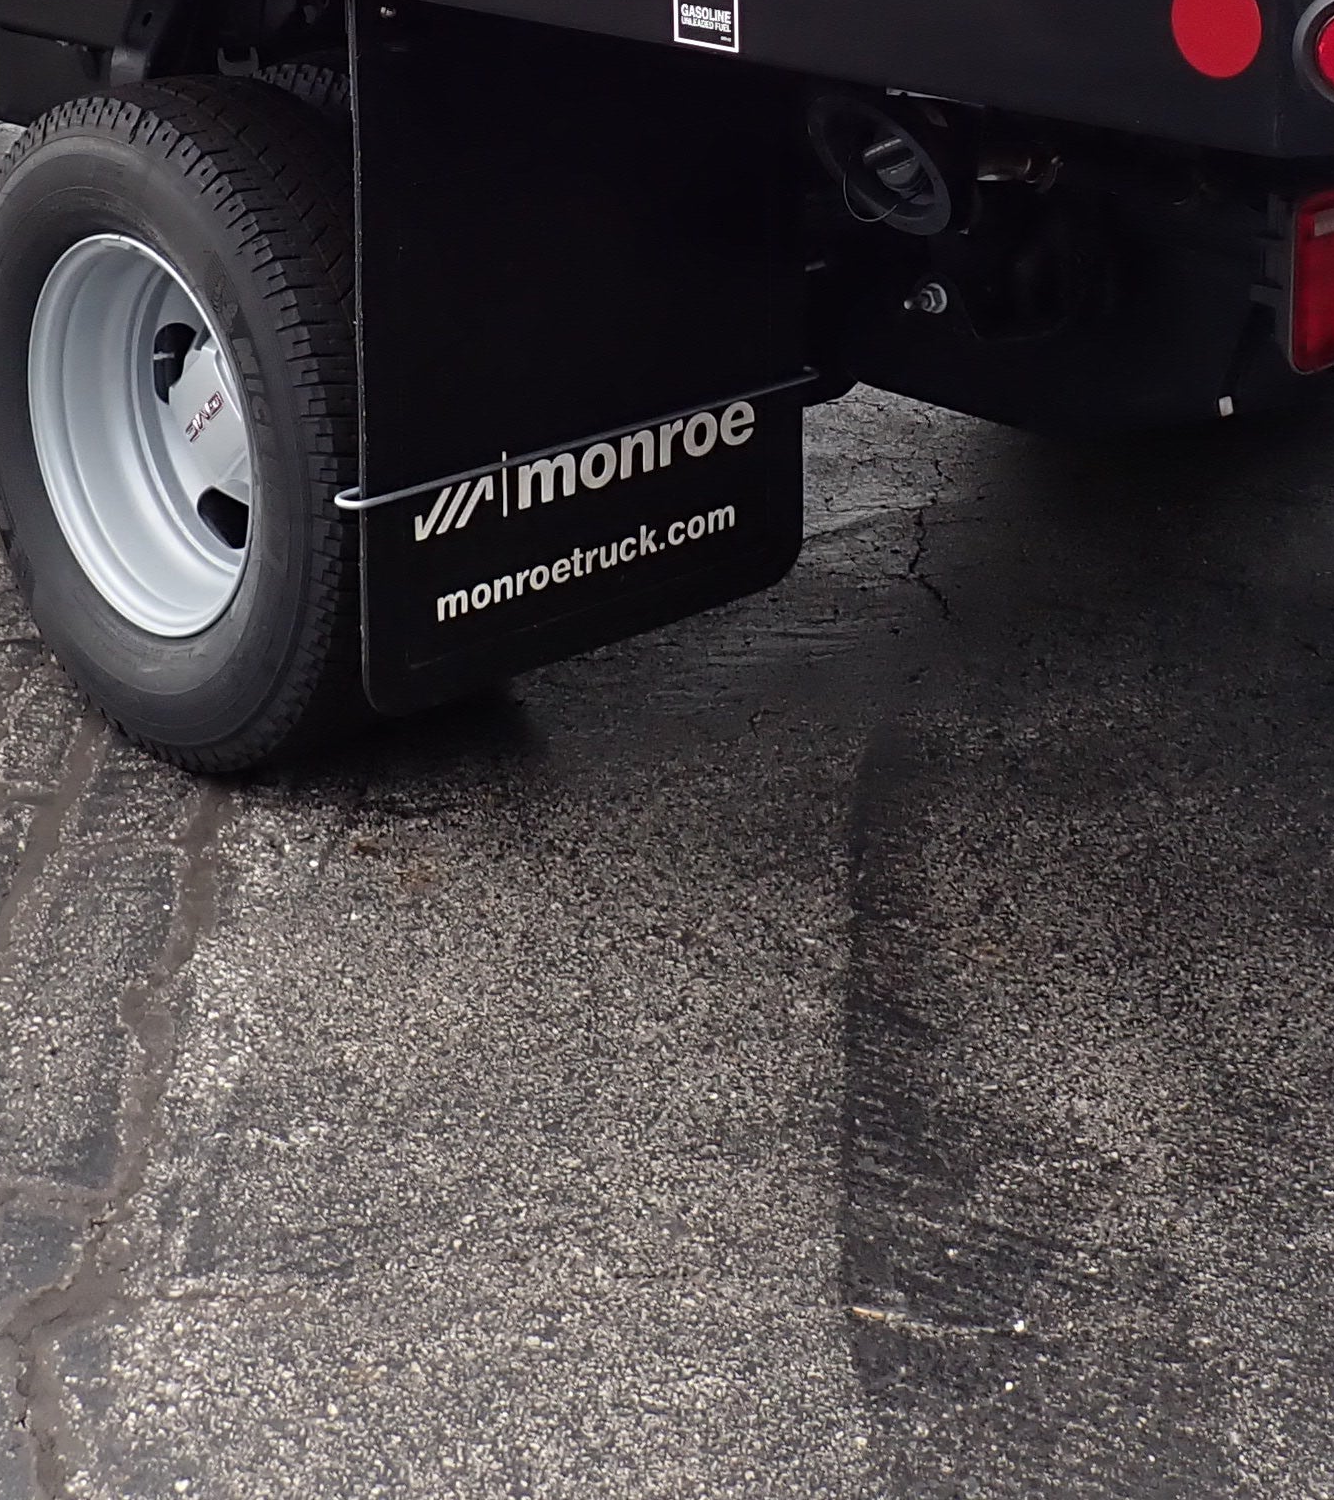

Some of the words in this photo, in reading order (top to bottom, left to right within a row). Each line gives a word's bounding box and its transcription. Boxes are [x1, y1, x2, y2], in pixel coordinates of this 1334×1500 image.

[681, 4, 731, 25] GASOLINE
[681, 16, 714, 29] UNLEADED
[715, 22, 731, 32] FUEL
[517, 400, 757, 510] monroe
[435, 504, 737, 623] monroetruck.com
